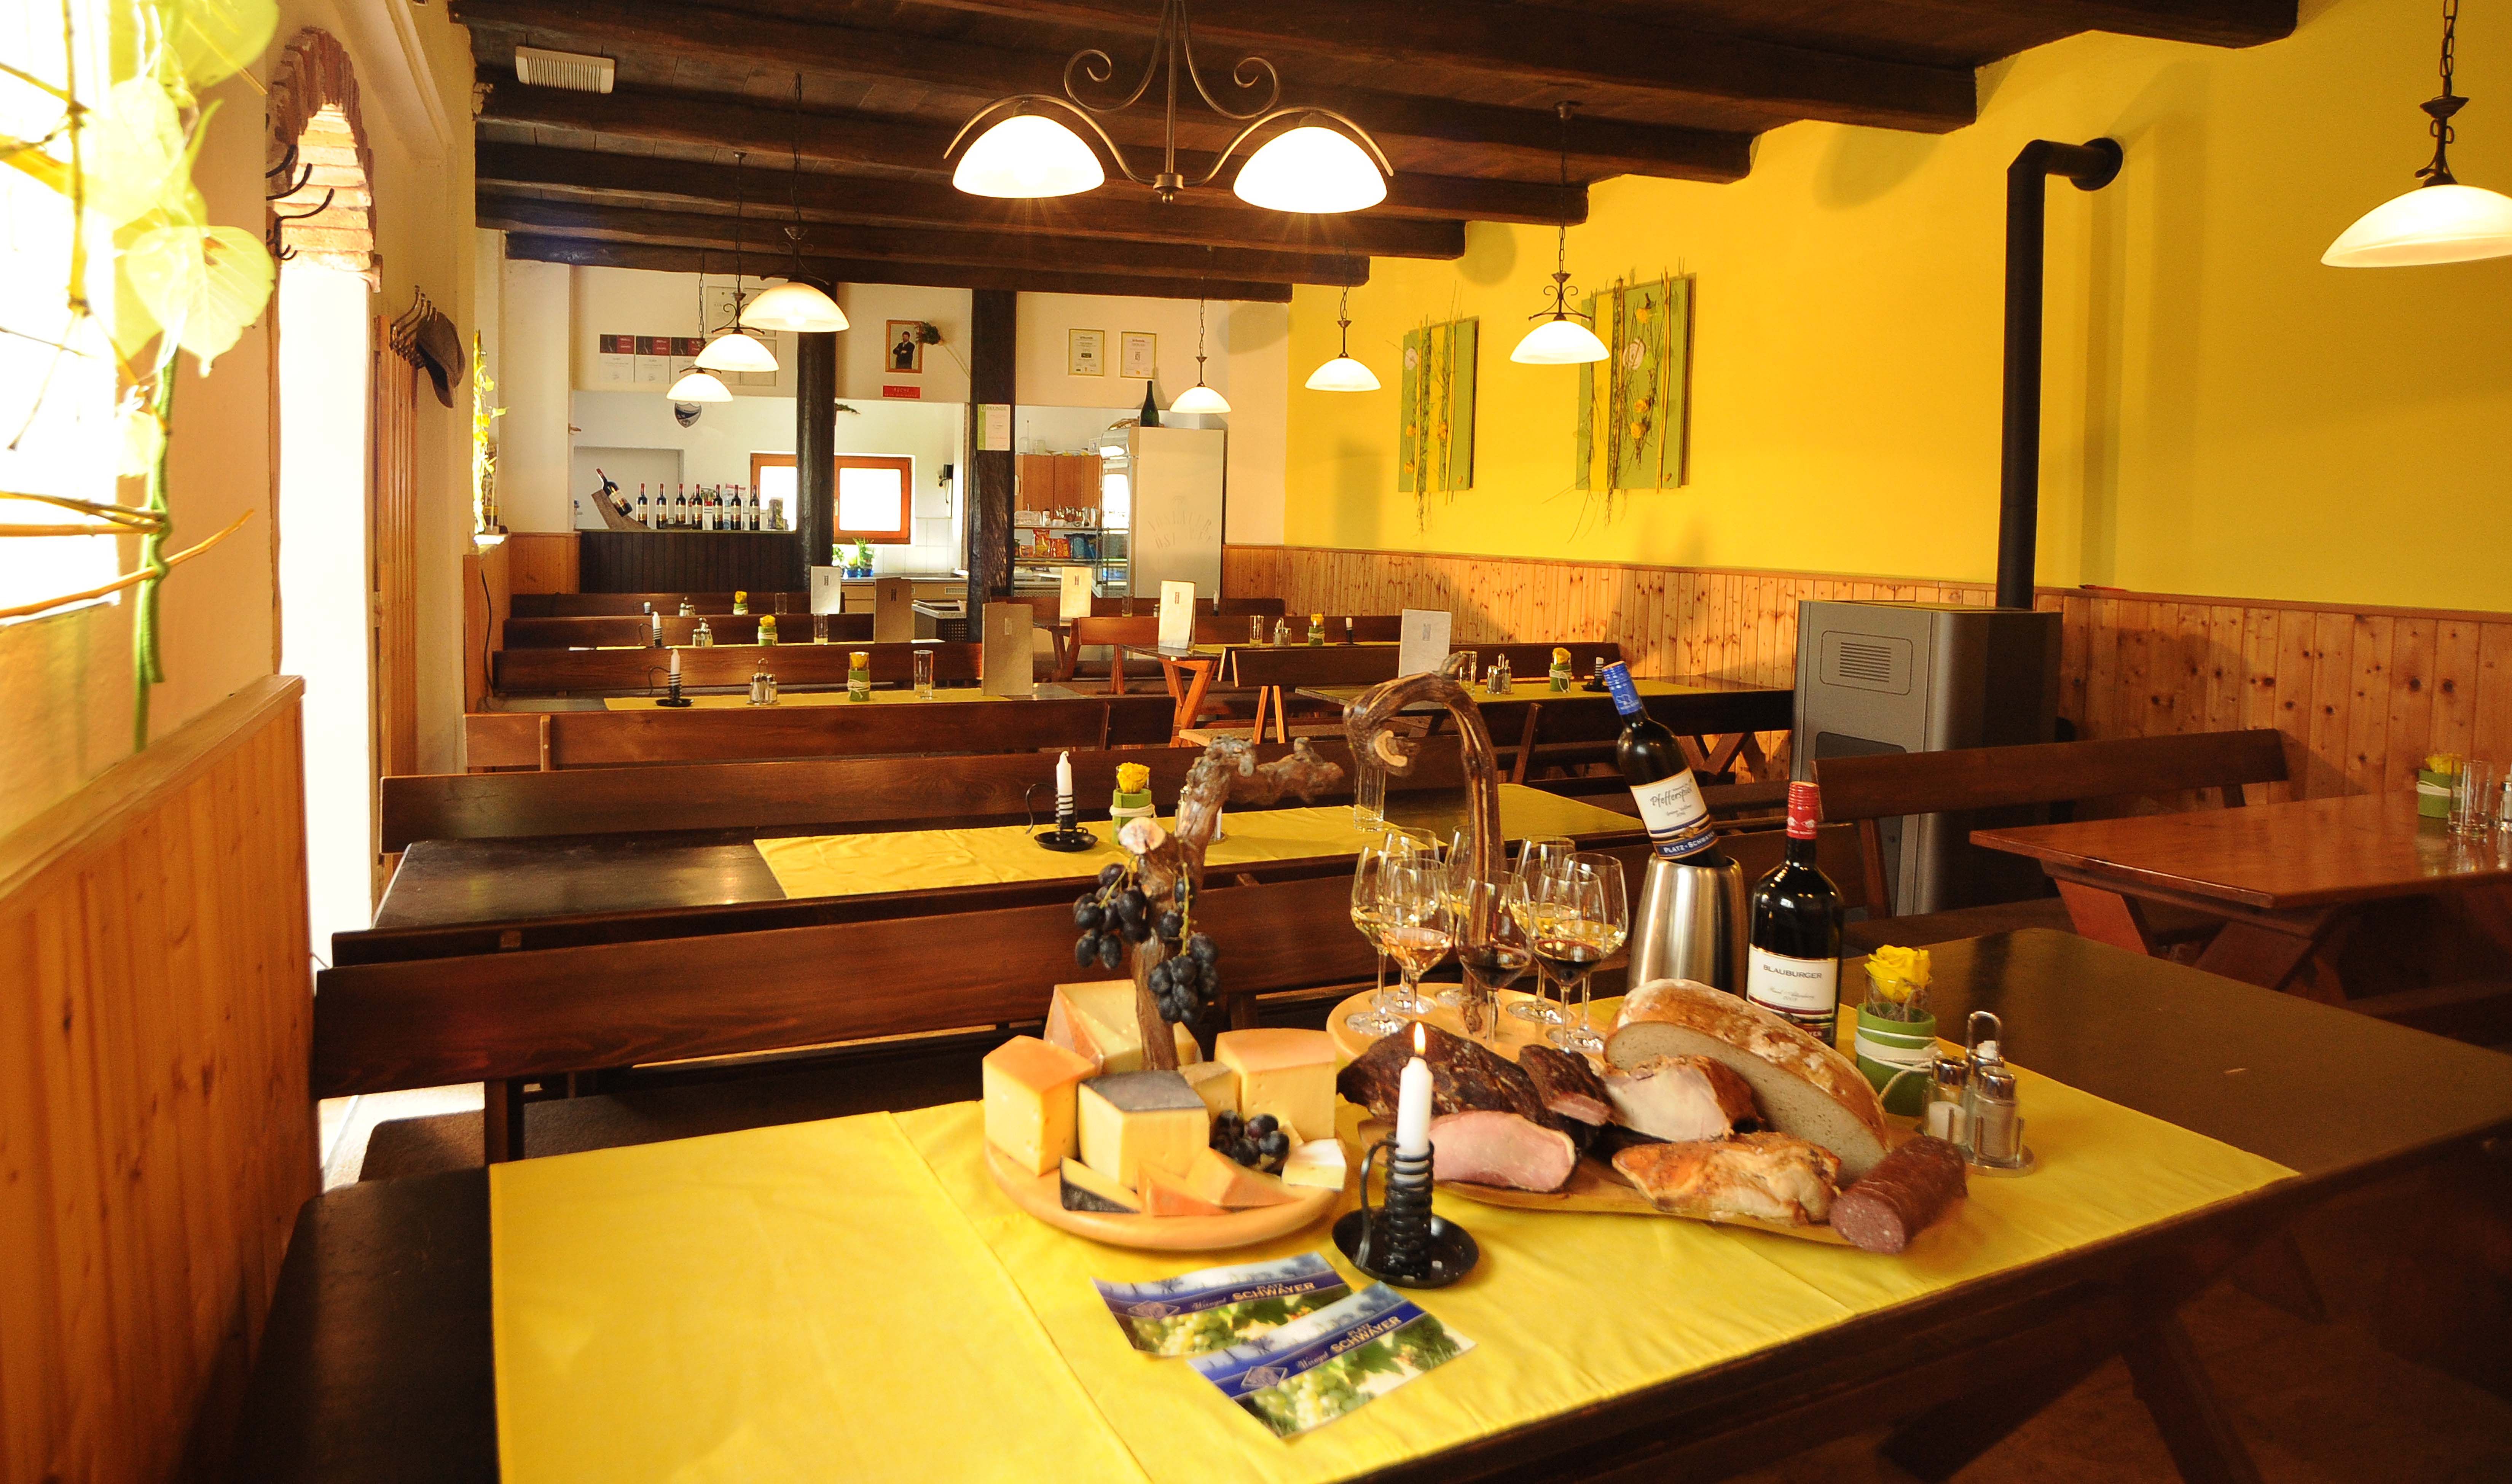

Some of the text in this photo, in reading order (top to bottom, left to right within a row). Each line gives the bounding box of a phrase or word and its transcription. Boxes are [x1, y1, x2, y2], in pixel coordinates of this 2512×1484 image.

[1763, 964, 1822, 979] BLAUBURGER
[1232, 1282, 1316, 1301] SCHWAYER
[1330, 1316, 1402, 1353] SCHWAYER
